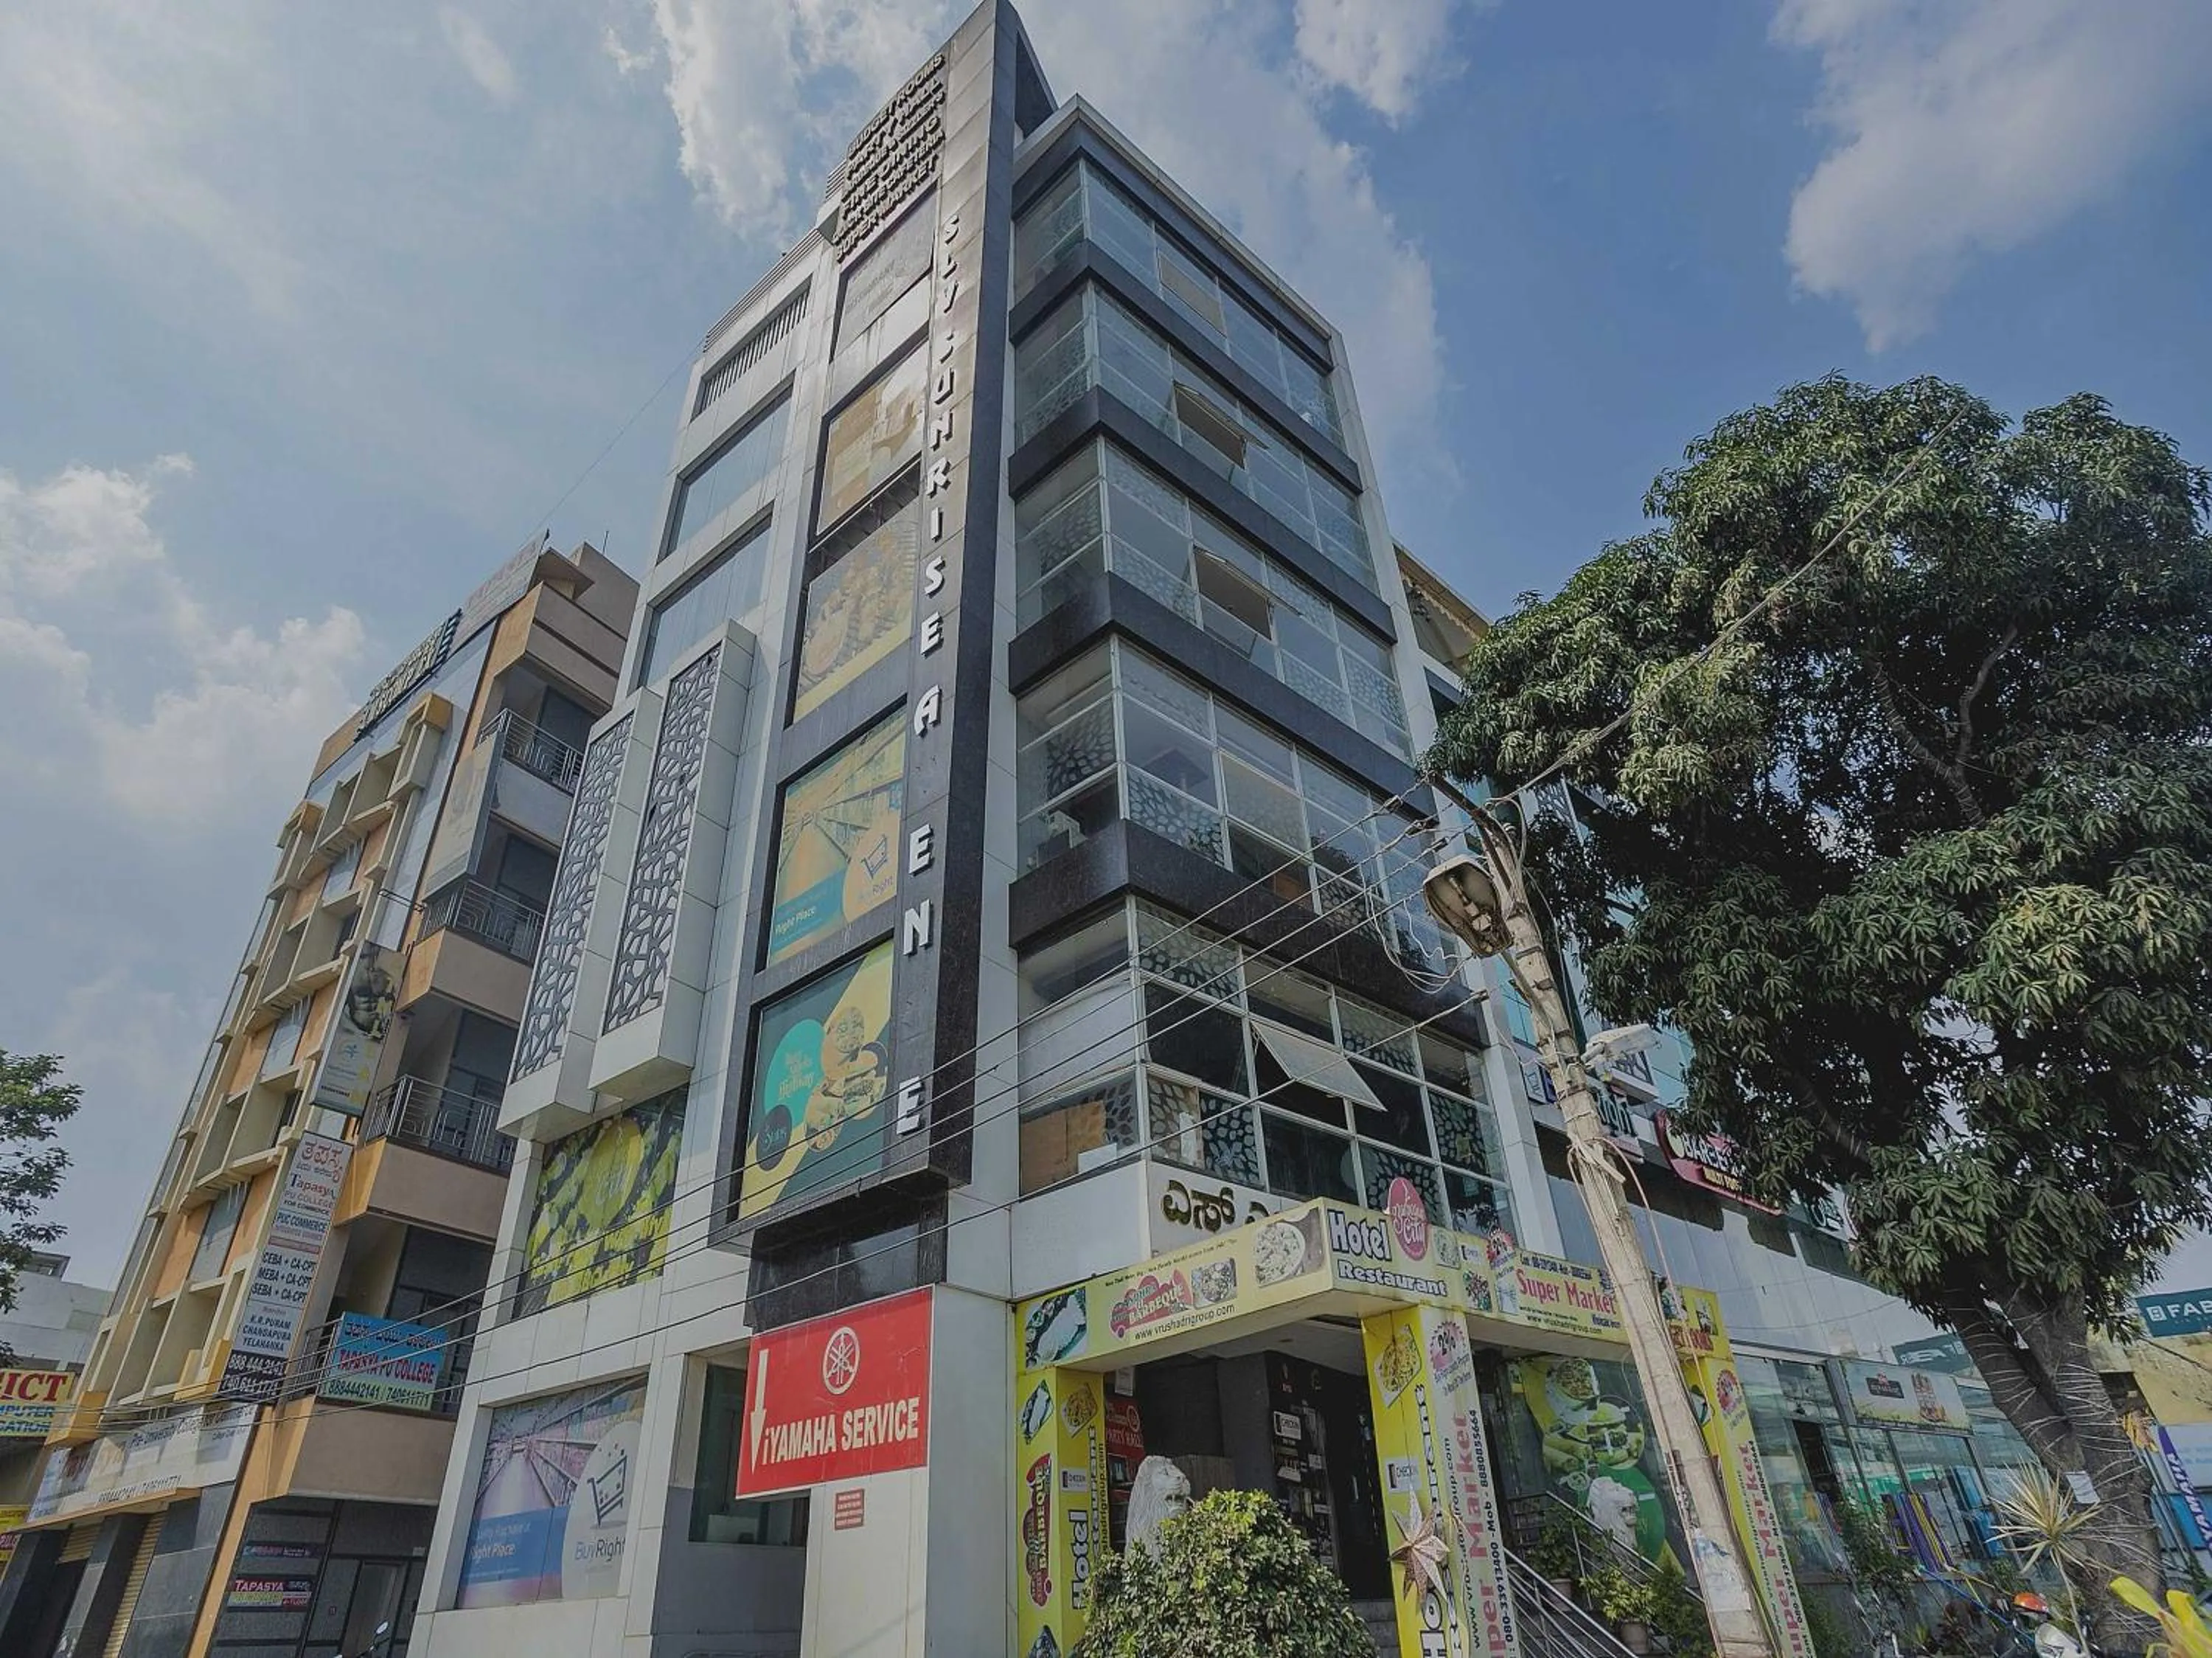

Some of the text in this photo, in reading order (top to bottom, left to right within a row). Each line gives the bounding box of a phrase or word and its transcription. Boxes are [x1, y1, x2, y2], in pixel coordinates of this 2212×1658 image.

[898, 53, 945, 108] ROOMS
[843, 116, 940, 221] FINE DINING
[847, 117, 898, 180] PARTY
[837, 212, 880, 264] SUPER
[880, 153, 939, 220] MARKET
[921, 327, 954, 659] SUNRISE
[1327, 1210, 1392, 1261] Hotel
[1338, 1258, 1447, 1297] Restaurant
[1516, 1268, 1559, 1305] Super
[1562, 1280, 1618, 1315] Market
[394, 1359, 436, 1384] COLLEGE
[841, 1396, 920, 1451] SERVICE
[1453, 1412, 1488, 1558] Market
[1738, 1443, 1778, 1558] Market
[235, 1579, 284, 1592] TAPASYA
[1068, 1510, 1091, 1611] Hotel
